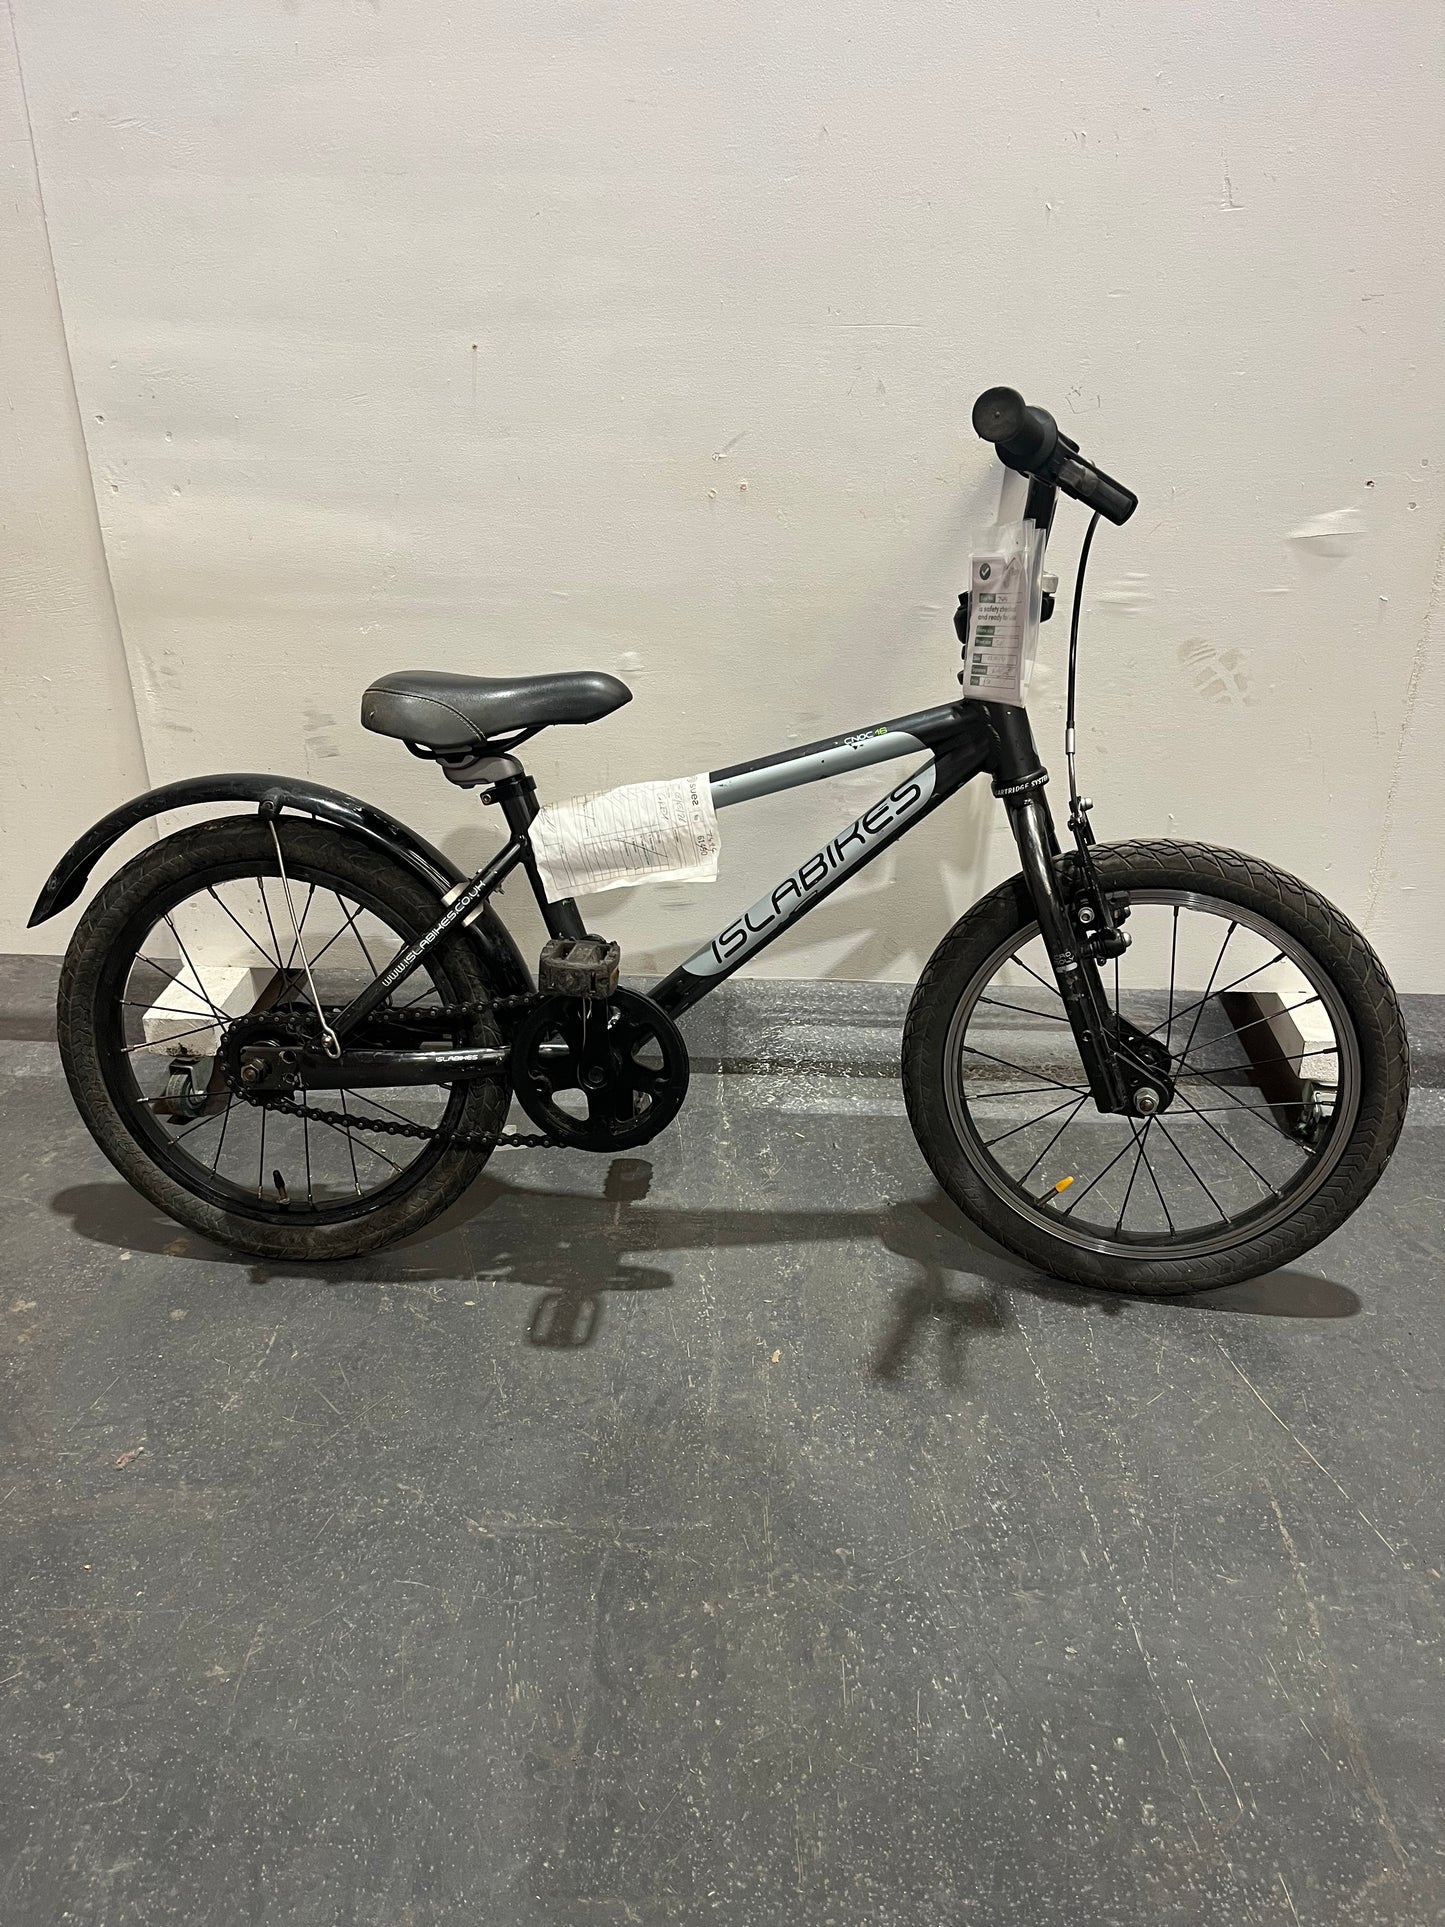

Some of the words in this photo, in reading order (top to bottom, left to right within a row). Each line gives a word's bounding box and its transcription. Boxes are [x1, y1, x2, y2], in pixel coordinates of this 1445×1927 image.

[844, 731, 874, 745] CNOC
[1031, 774, 1048, 787] SYSTE
[712, 783, 920, 963] ISLABIKES
[436, 1054, 478, 1062] ISLABIKES
